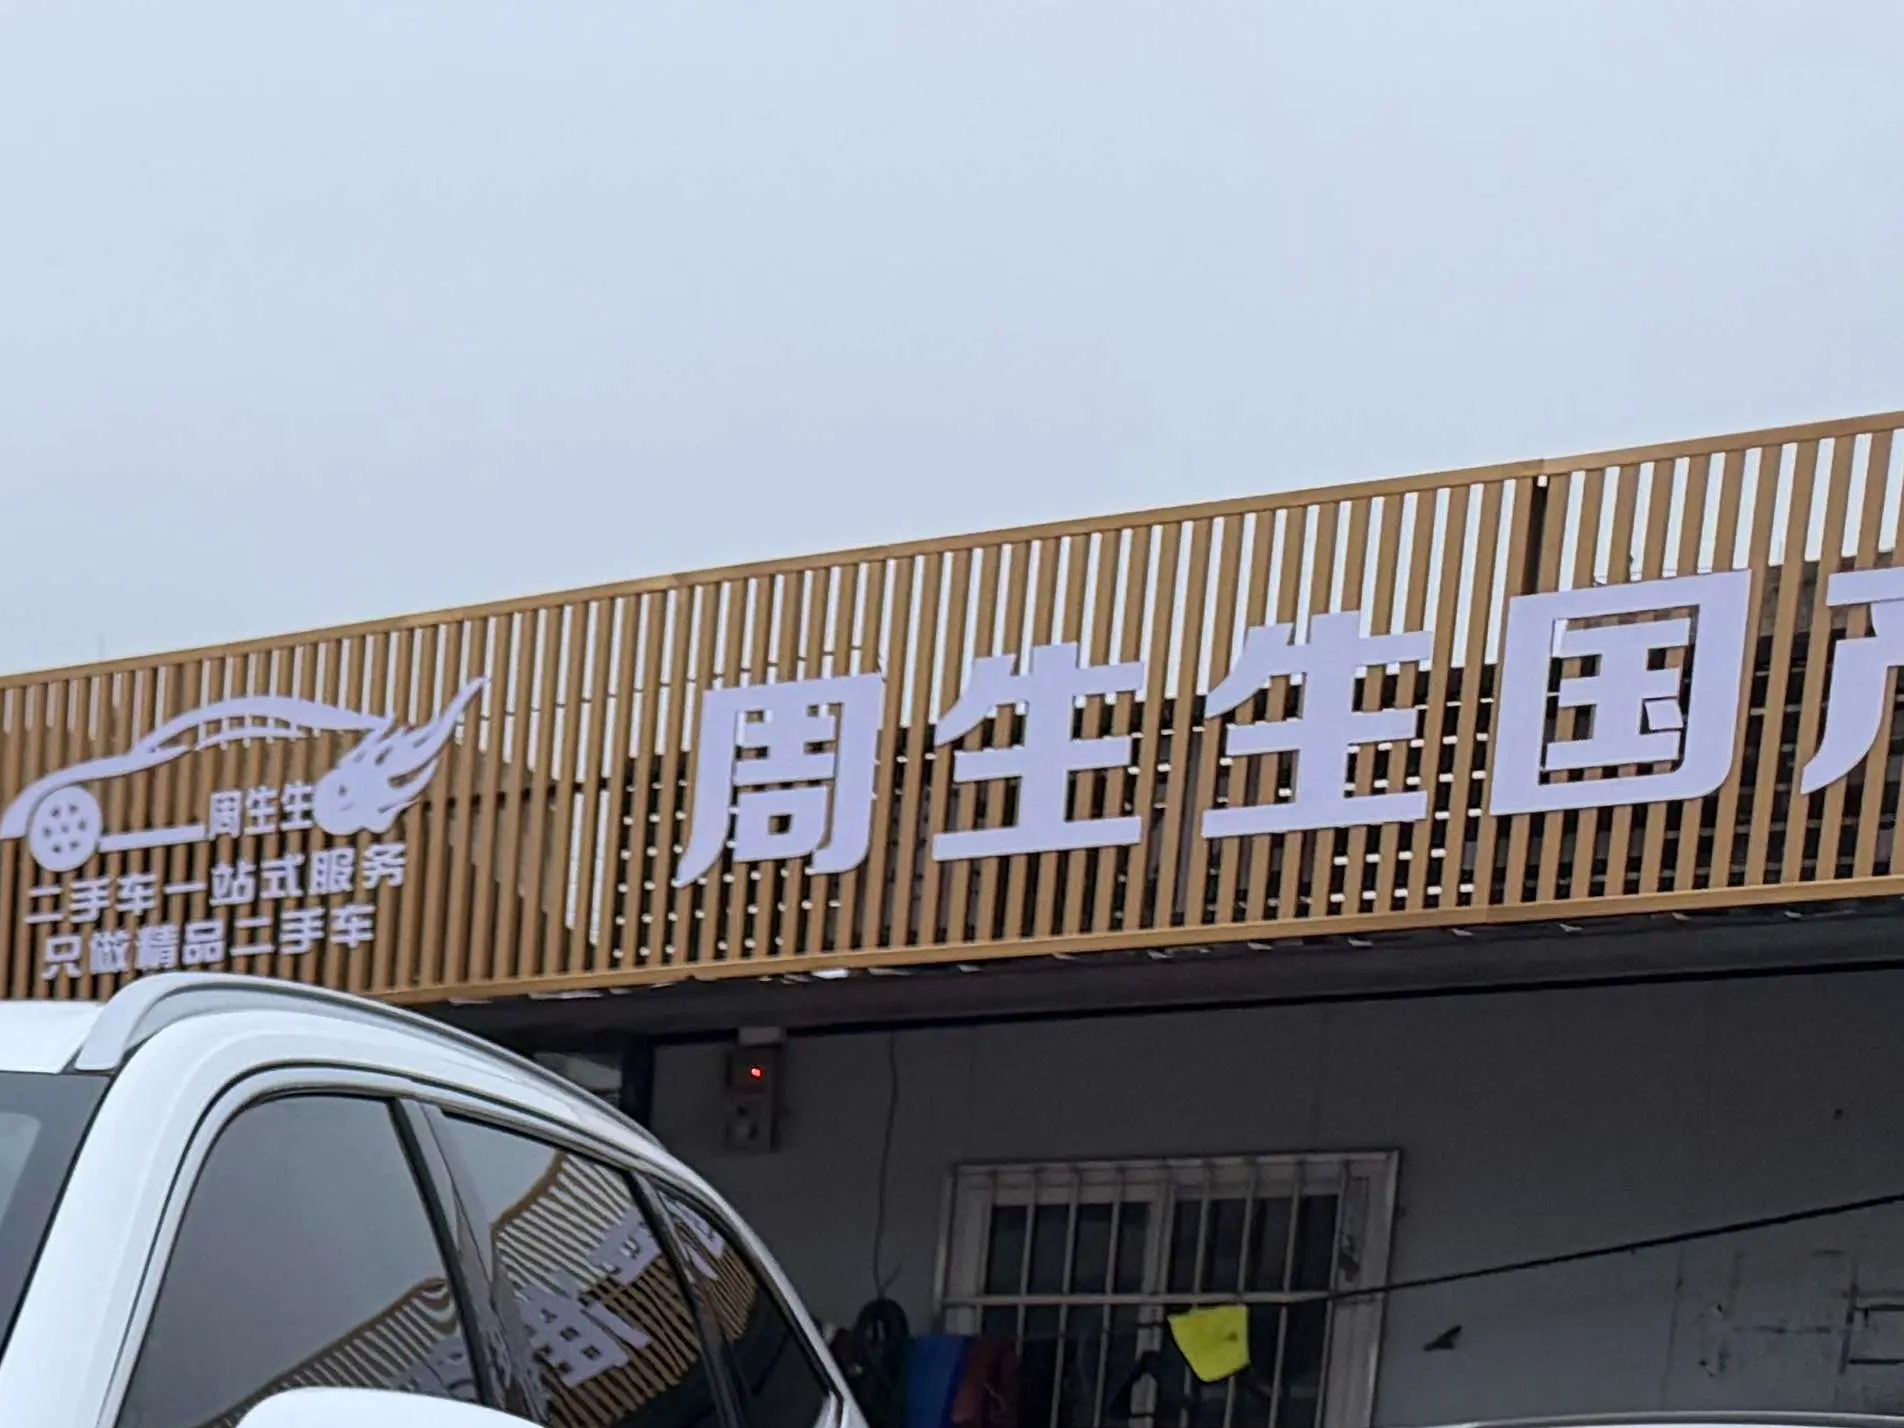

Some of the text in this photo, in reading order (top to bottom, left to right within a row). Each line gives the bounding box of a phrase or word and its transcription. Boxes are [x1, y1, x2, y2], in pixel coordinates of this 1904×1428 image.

[209, 781, 315, 840] 周生生
[24, 842, 407, 924] 二手车一站式服务
[41, 903, 376, 981] 只做精品二手车
